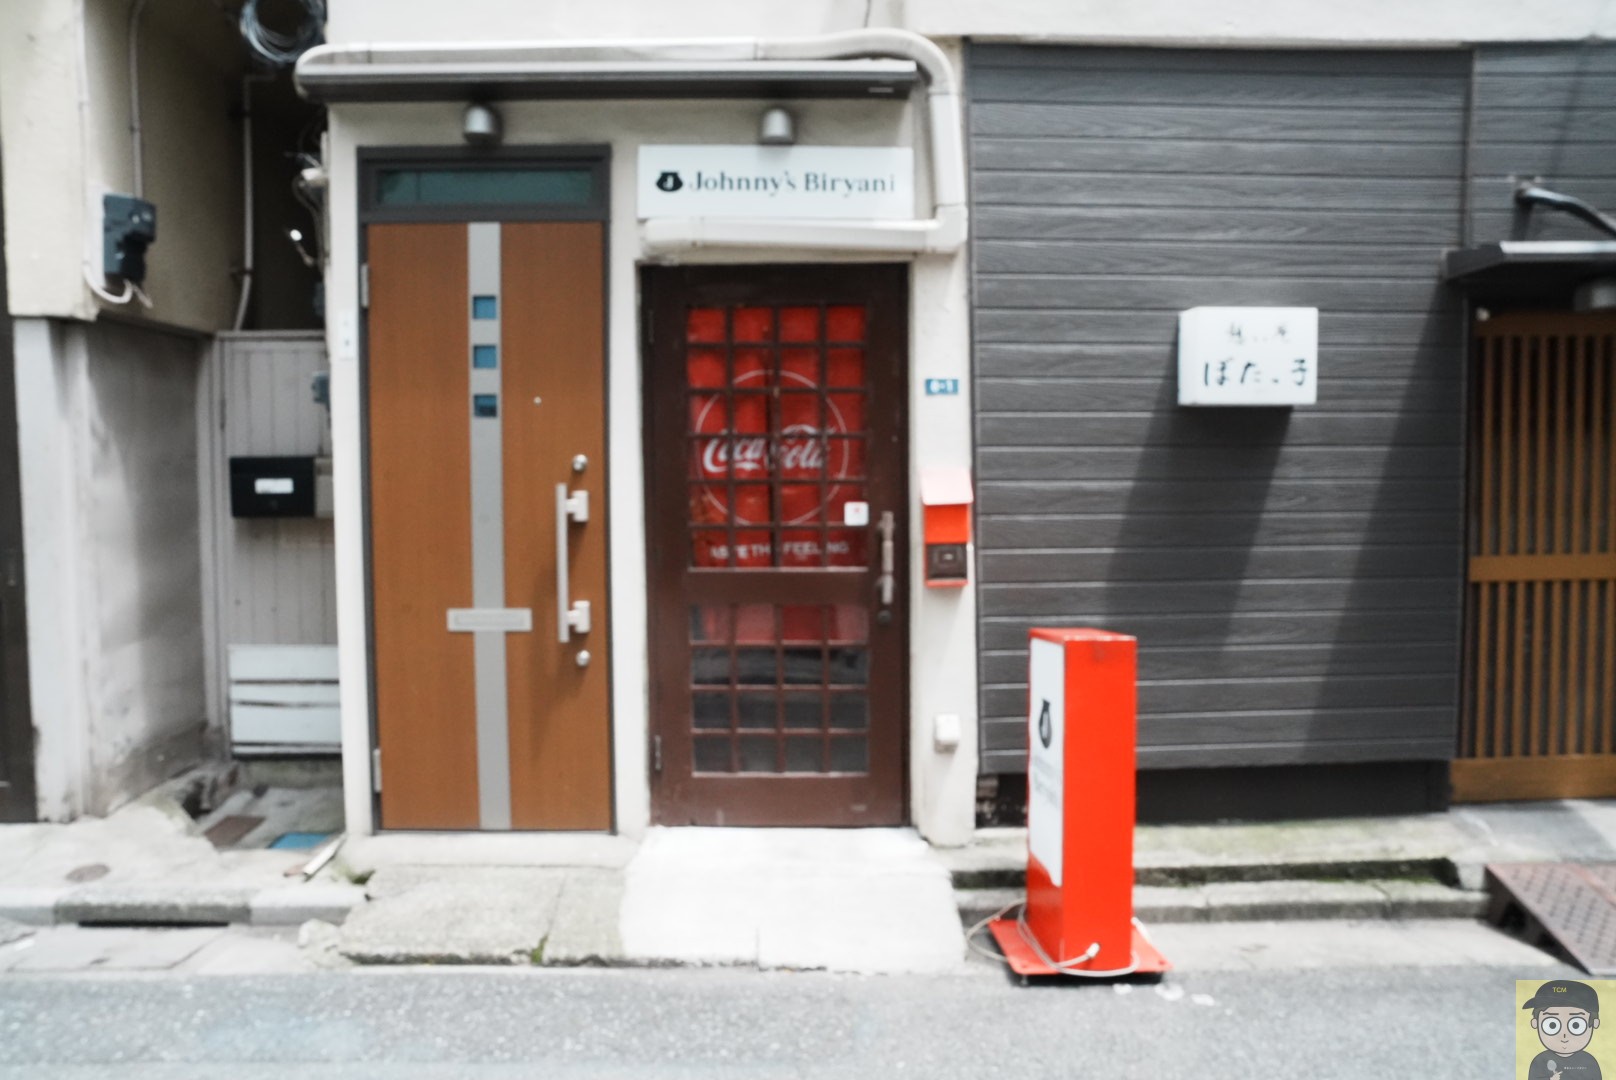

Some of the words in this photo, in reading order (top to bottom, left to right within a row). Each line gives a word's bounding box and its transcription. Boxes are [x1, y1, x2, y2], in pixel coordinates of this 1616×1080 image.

[689, 171, 797, 196] Johnny's
[804, 172, 895, 196] Biryani
[703, 424, 835, 473] CocaCola
[783, 540, 849, 555] FEELNG
